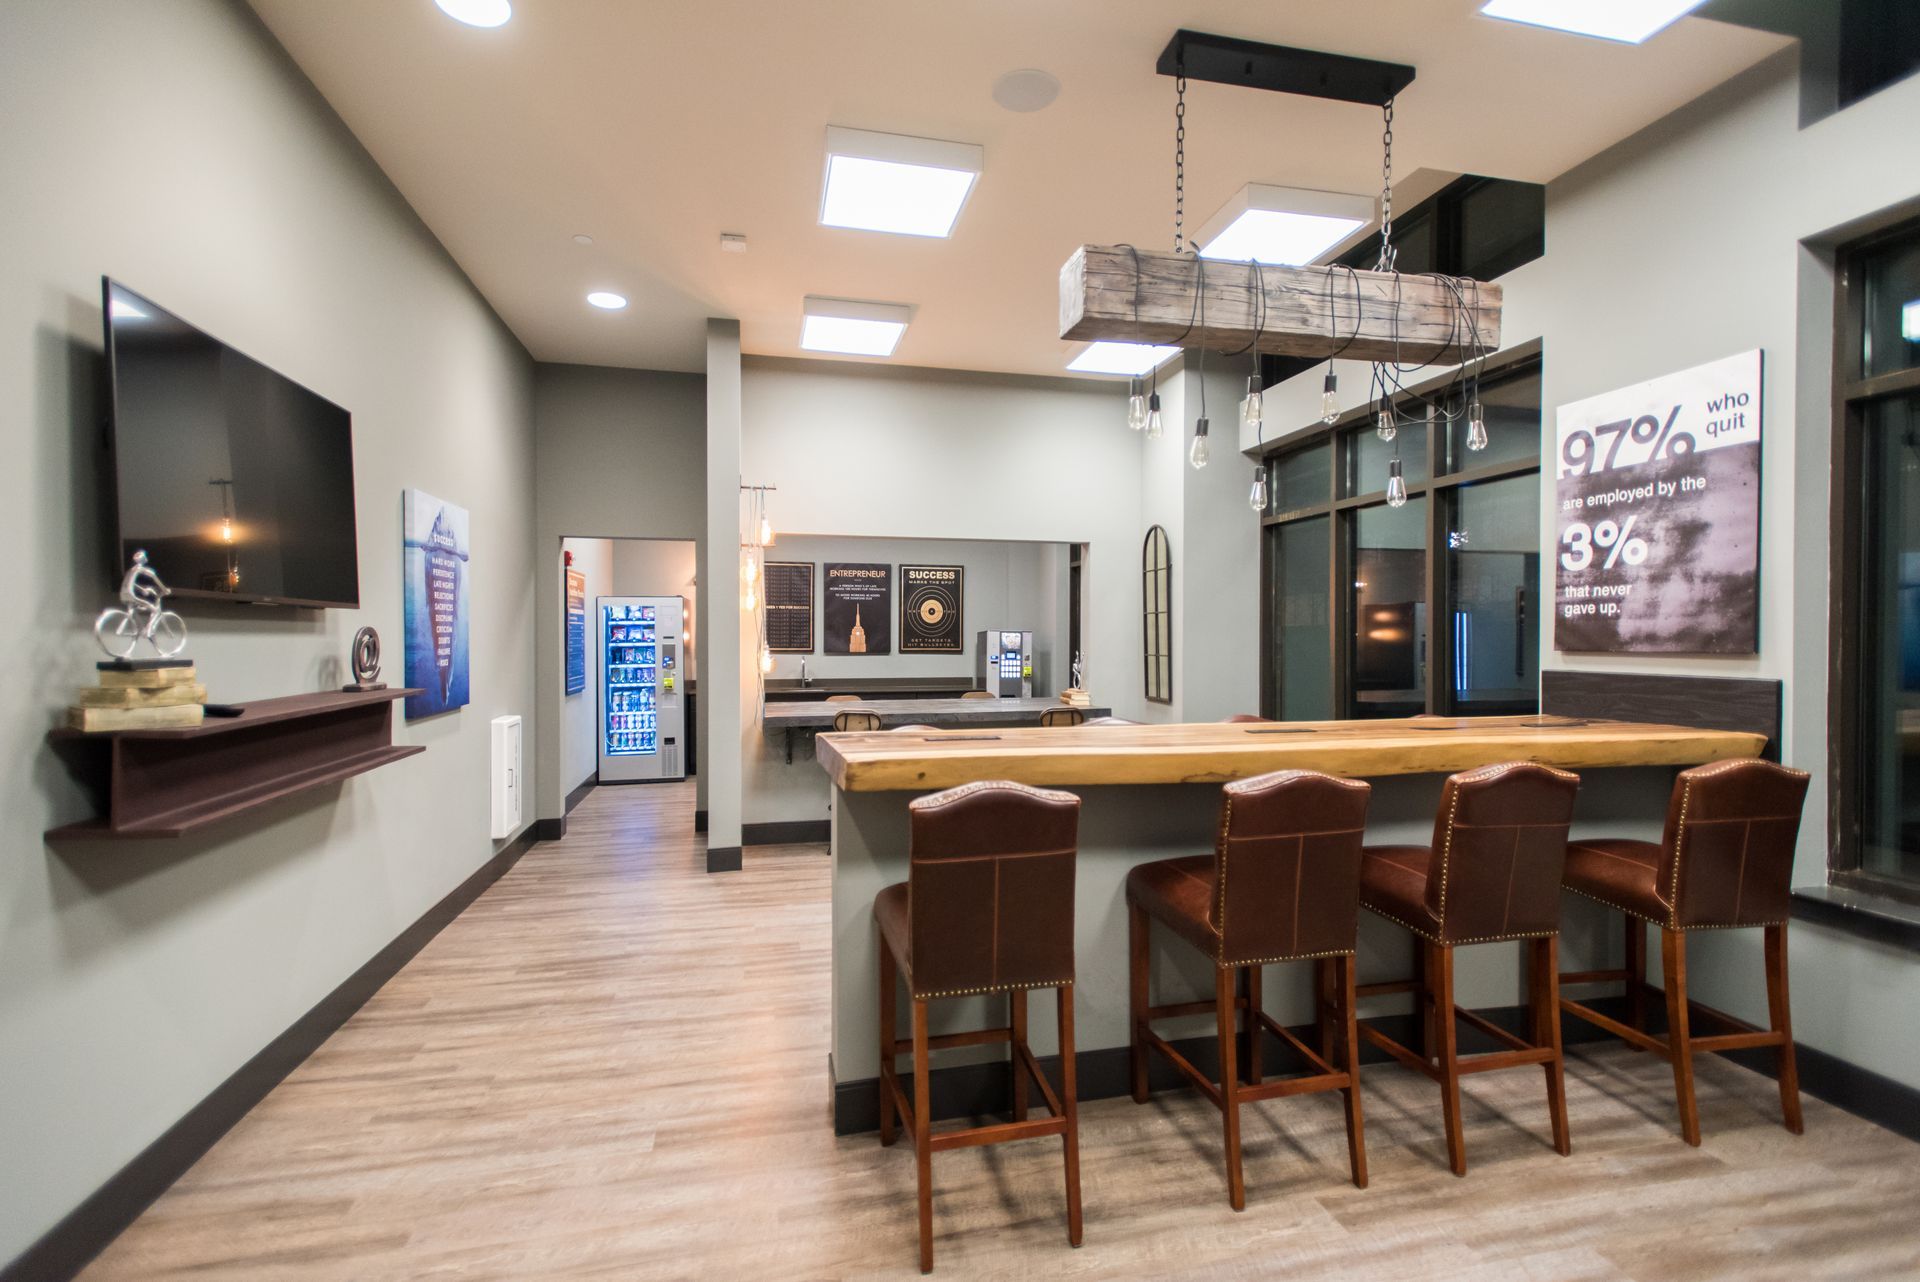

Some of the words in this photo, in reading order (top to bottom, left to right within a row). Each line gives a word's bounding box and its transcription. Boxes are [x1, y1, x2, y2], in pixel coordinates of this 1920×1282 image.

[1706, 392, 1749, 413] who
[1706, 413, 1745, 438] quit
[1562, 404, 1696, 480] 97%
[1563, 497, 1583, 510] are
[1587, 482, 1654, 507] employed
[1658, 477, 1677, 496] by
[1681, 475, 1706, 492] the
[433, 534, 454, 546] SUCCESS
[1561, 515, 1648, 571] 3%
[830, 570, 886, 578] ENTREPRENEUR
[908, 570, 955, 579] SUCCESS
[1565, 584, 1591, 598] that
[1594, 584, 1632, 598] never
[1564, 602, 1596, 617] gave
[1600, 602, 1621, 616] up.
